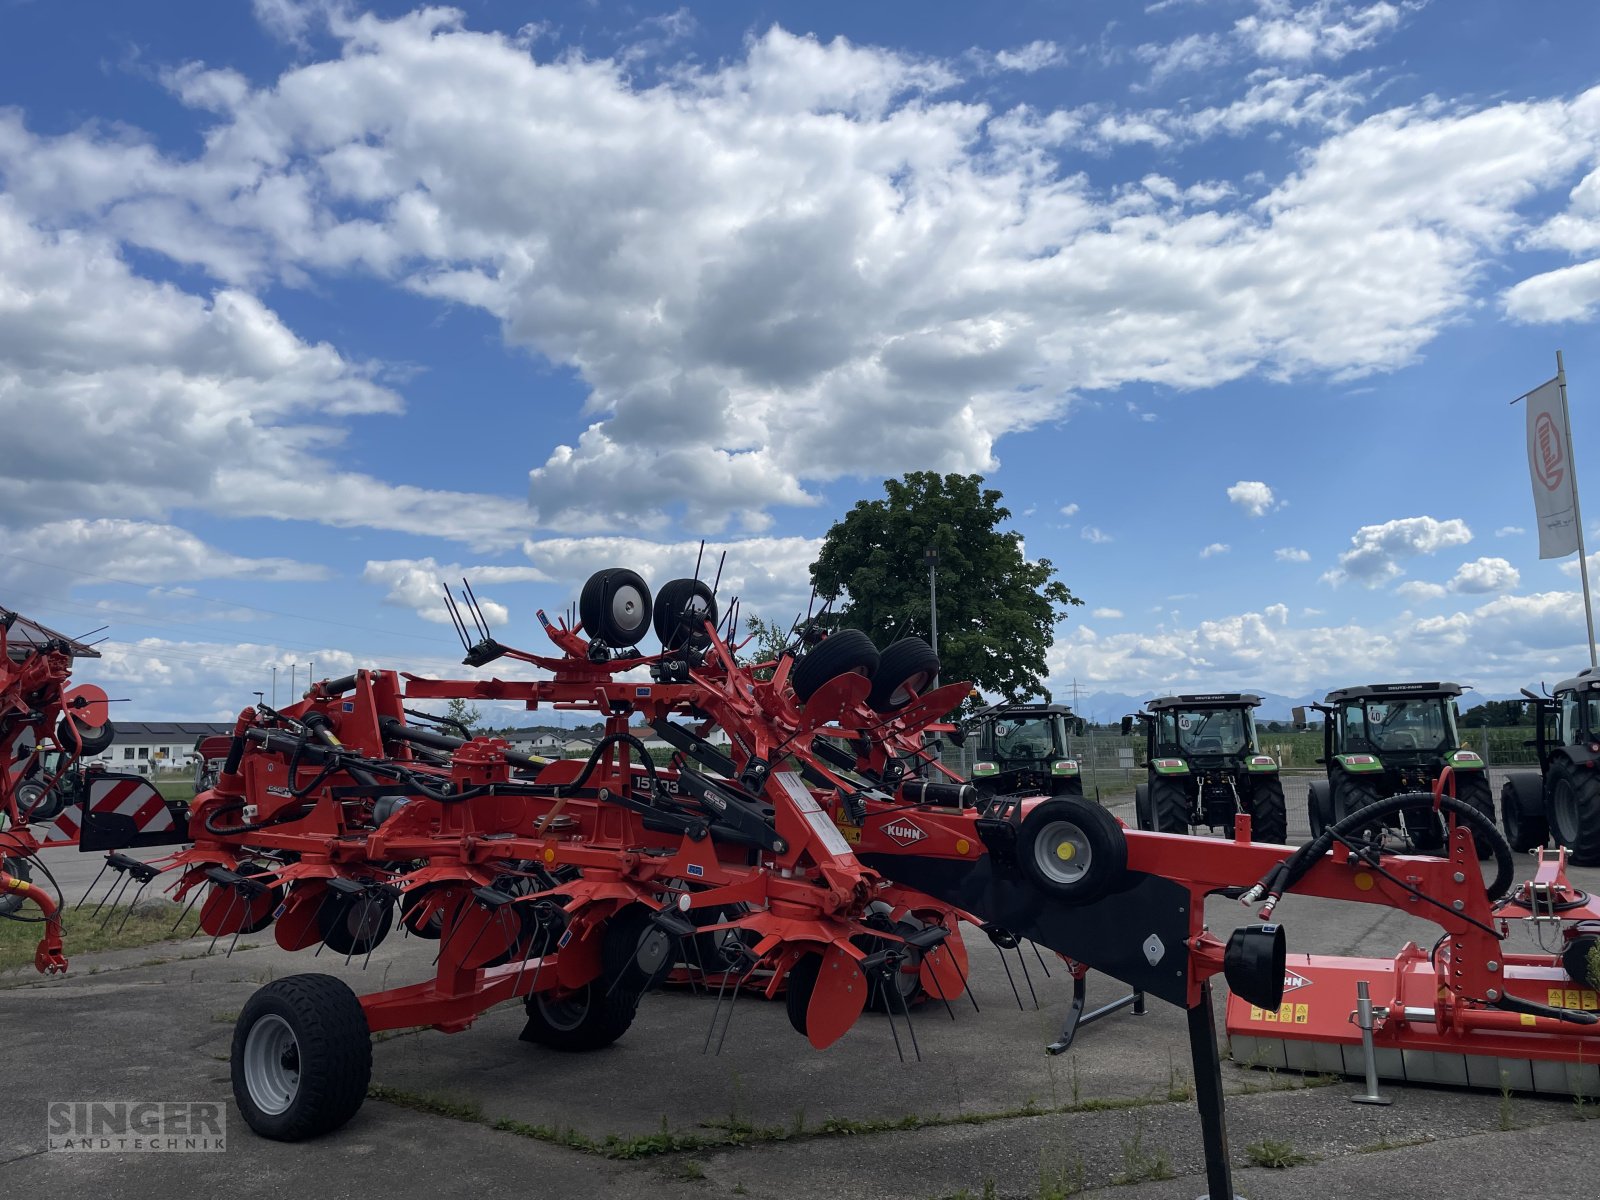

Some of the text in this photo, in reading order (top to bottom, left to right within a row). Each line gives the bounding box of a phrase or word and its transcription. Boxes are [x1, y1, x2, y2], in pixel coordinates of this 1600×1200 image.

[1370, 710, 1381, 721] 40
[1180, 719, 1190, 728] 40
[997, 726, 1005, 734] 40
[635, 776, 680, 794] 1503
[887, 825, 920, 840] KUHN
[1284, 977, 1302, 987] HN
